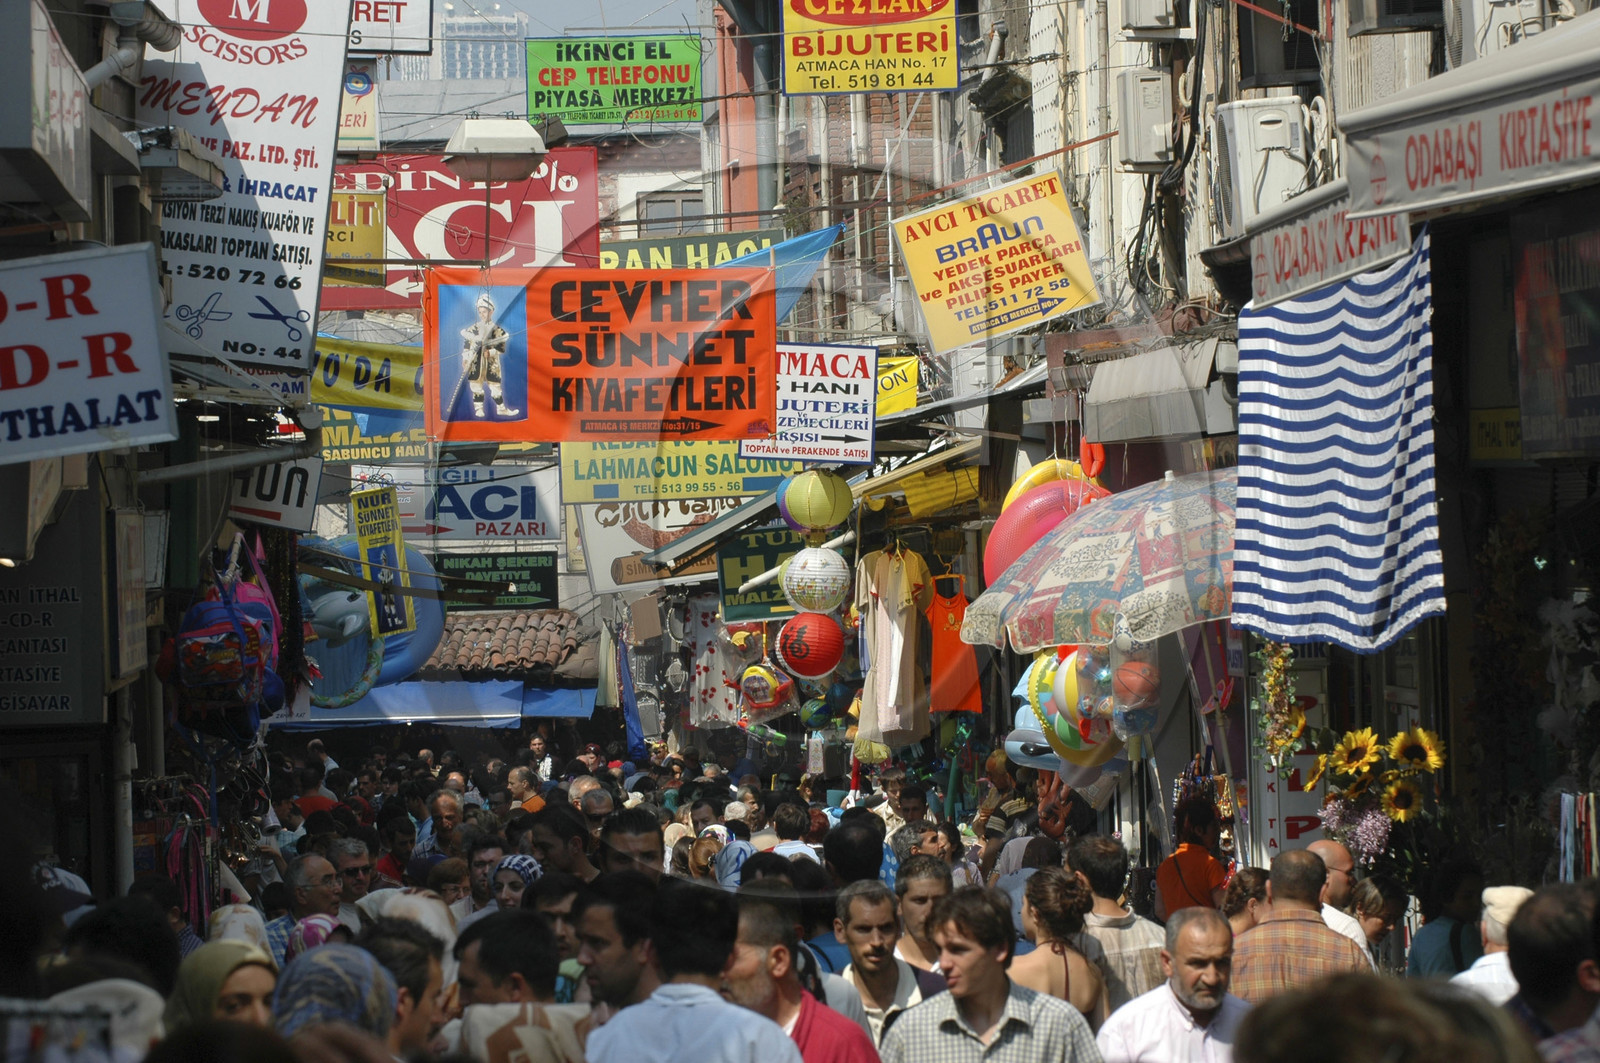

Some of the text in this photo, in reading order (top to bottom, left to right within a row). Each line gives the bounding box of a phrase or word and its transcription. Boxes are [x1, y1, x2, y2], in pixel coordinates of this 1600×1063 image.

[354, 0, 407, 23] RET
[184, 25, 308, 65] SCISSORS
[645, 42, 671, 59] EL
[792, 24, 948, 57] BİJUTERİ
[538, 64, 690, 87] CEP TELEFONU
[796, 56, 947, 73] ATMACA HAN No. 17
[809, 72, 934, 89] Tel. 519 81 44
[140, 75, 318, 129] MEYDAN
[534, 86, 694, 108] PİYASA MERKEZİ
[687, 109, 697, 118] 96
[1405, 86, 1592, 192] ODABAŞI KIRTASİYE
[221, 140, 255, 161] PAZ.
[259, 144, 288, 164] LTD.
[293, 146, 319, 172] ŞTİ.
[238, 175, 318, 203] İHRACAT
[200, 203, 226, 225] TERZİ
[228, 207, 258, 233] NAKIŞ
[260, 210, 300, 234] KUAFÖR
[302, 216, 314, 235] VE
[905, 177, 1058, 243] AVCI TİCARET
[387, 199, 575, 268] CI
[221, 237, 269, 260] TOPTAN
[271, 243, 313, 270] SATIŞI.
[933, 233, 1057, 282] YEDEK PARÇA
[187, 264, 230, 282] 520
[238, 269, 266, 286] 72
[274, 275, 302, 290] 66
[920, 240, 1082, 303] ve AKSESUARLARI
[1009, 262, 1066, 289] PAYER
[1024, 286, 1045, 299] 72
[1049, 278, 1071, 291] 58
[550, 280, 754, 323] CEVHER
[222, 340, 302, 360] NO: 44
[552, 325, 755, 368] SÜNNET
[552, 367, 756, 412] KIYAFETLERİ
[791, 381, 859, 395] HANI
[585, 422, 617, 431] ATMACA
[322, 445, 425, 461] SABUNCU HAN
[745, 445, 778, 454] TOPTAN
[792, 446, 840, 456] PERAKENDE
[844, 449, 868, 460] SATIŞI
[574, 456, 697, 481] LAHMACUN
[634, 485, 658, 494] TEL:
[662, 483, 682, 493] 513
[685, 482, 699, 492] 99
[702, 482, 716, 492] 55
[727, 481, 741, 491] 56
[357, 493, 392, 510] NUR
[424, 485, 537, 521] ACI
[357, 506, 395, 525] SÜNNET
[475, 522, 546, 536] PAZARI
[29, 585, 80, 604] İTHAL
